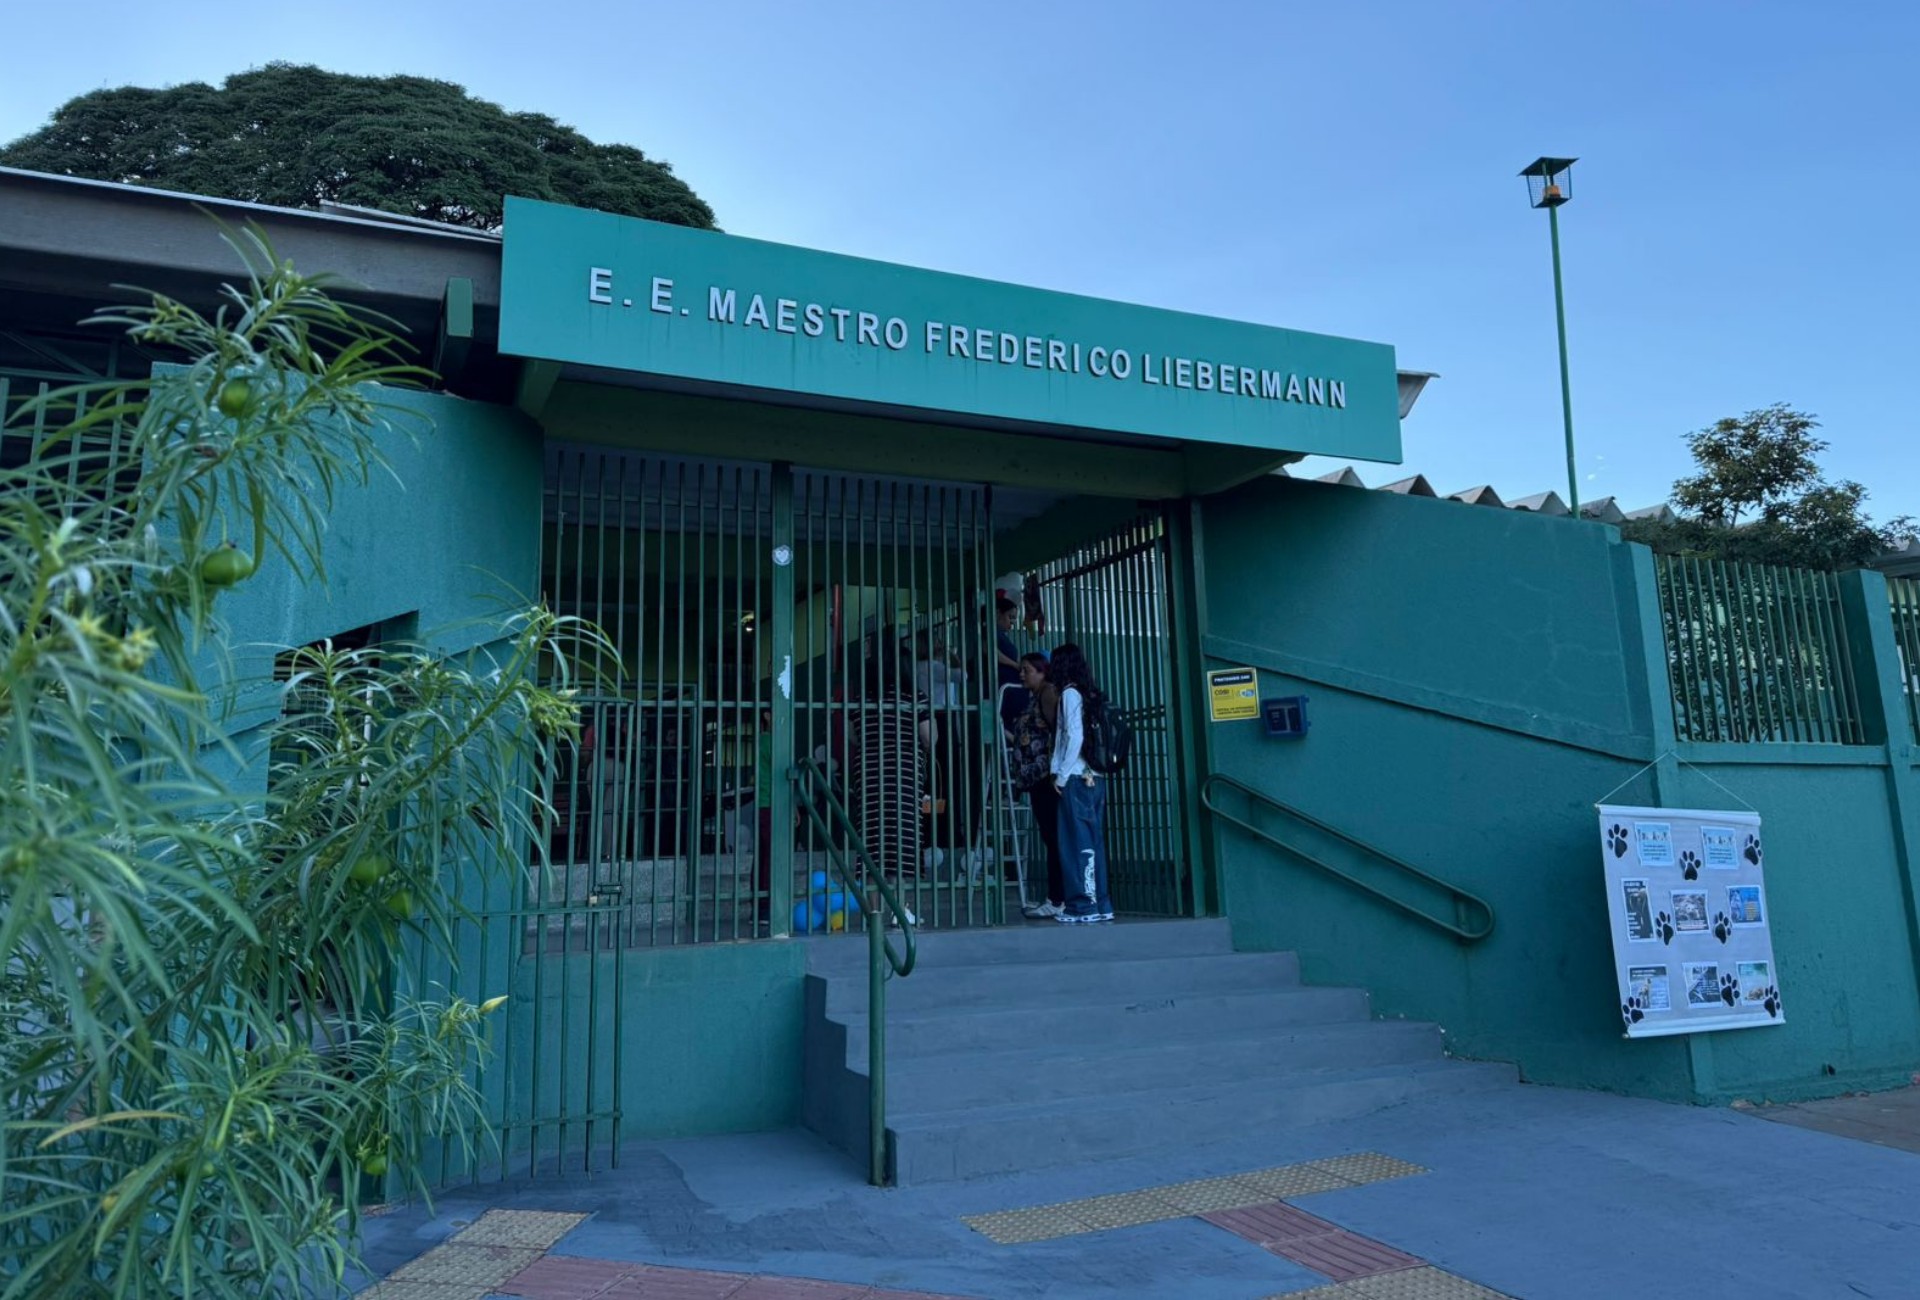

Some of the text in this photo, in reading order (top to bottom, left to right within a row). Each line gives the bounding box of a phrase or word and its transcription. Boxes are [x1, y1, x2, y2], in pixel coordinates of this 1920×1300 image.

[589, 267, 1347, 408] E. E. MAESTRO FREDERICO LIEBERMANN
